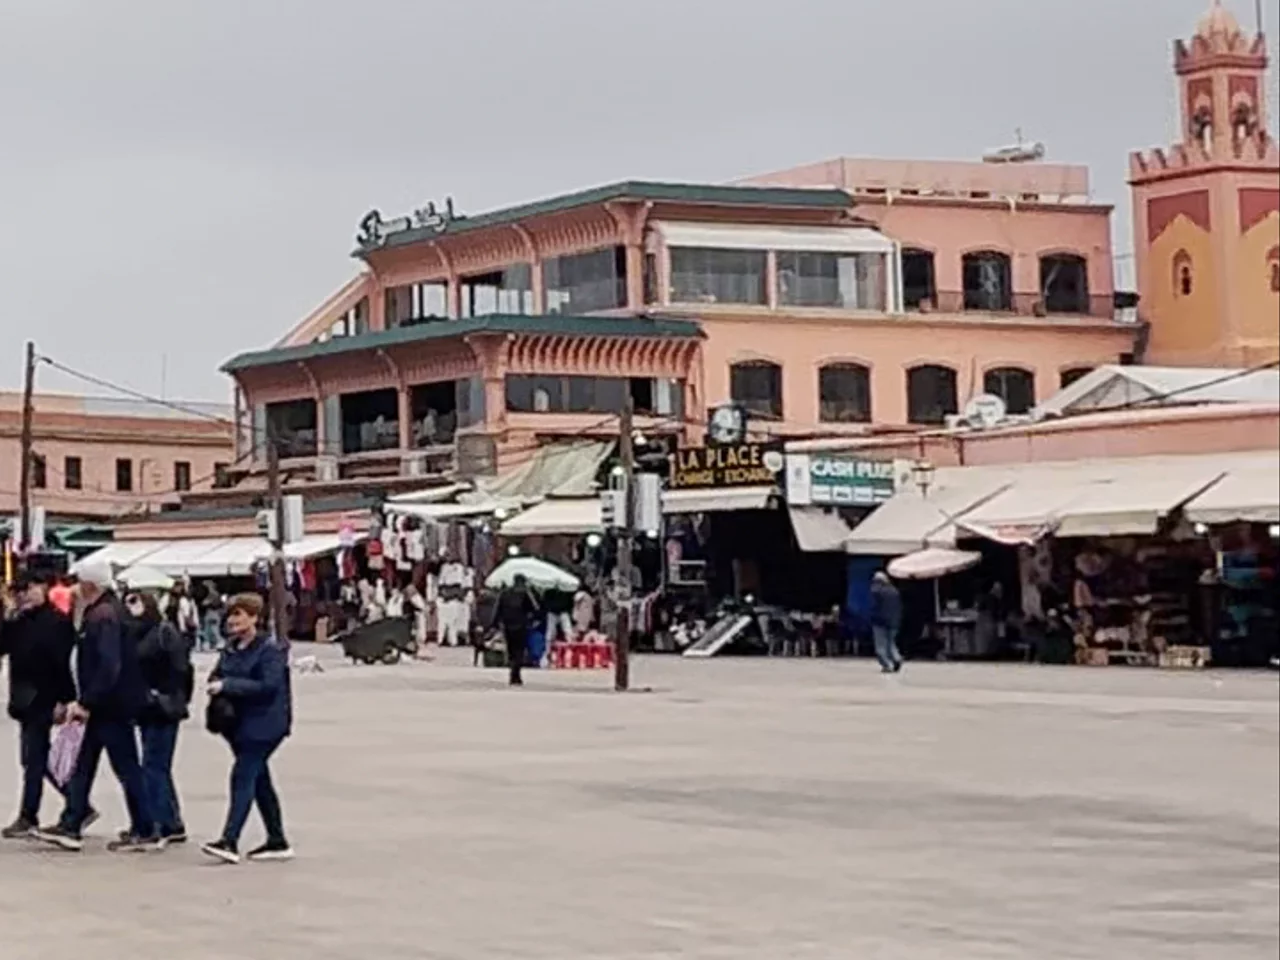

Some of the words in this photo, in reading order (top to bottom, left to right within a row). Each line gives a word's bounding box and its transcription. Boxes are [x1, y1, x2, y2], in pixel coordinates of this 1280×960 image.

[679, 450, 700, 470] LA
[706, 444, 760, 468] PLACE
[811, 460, 854, 477] CASH
